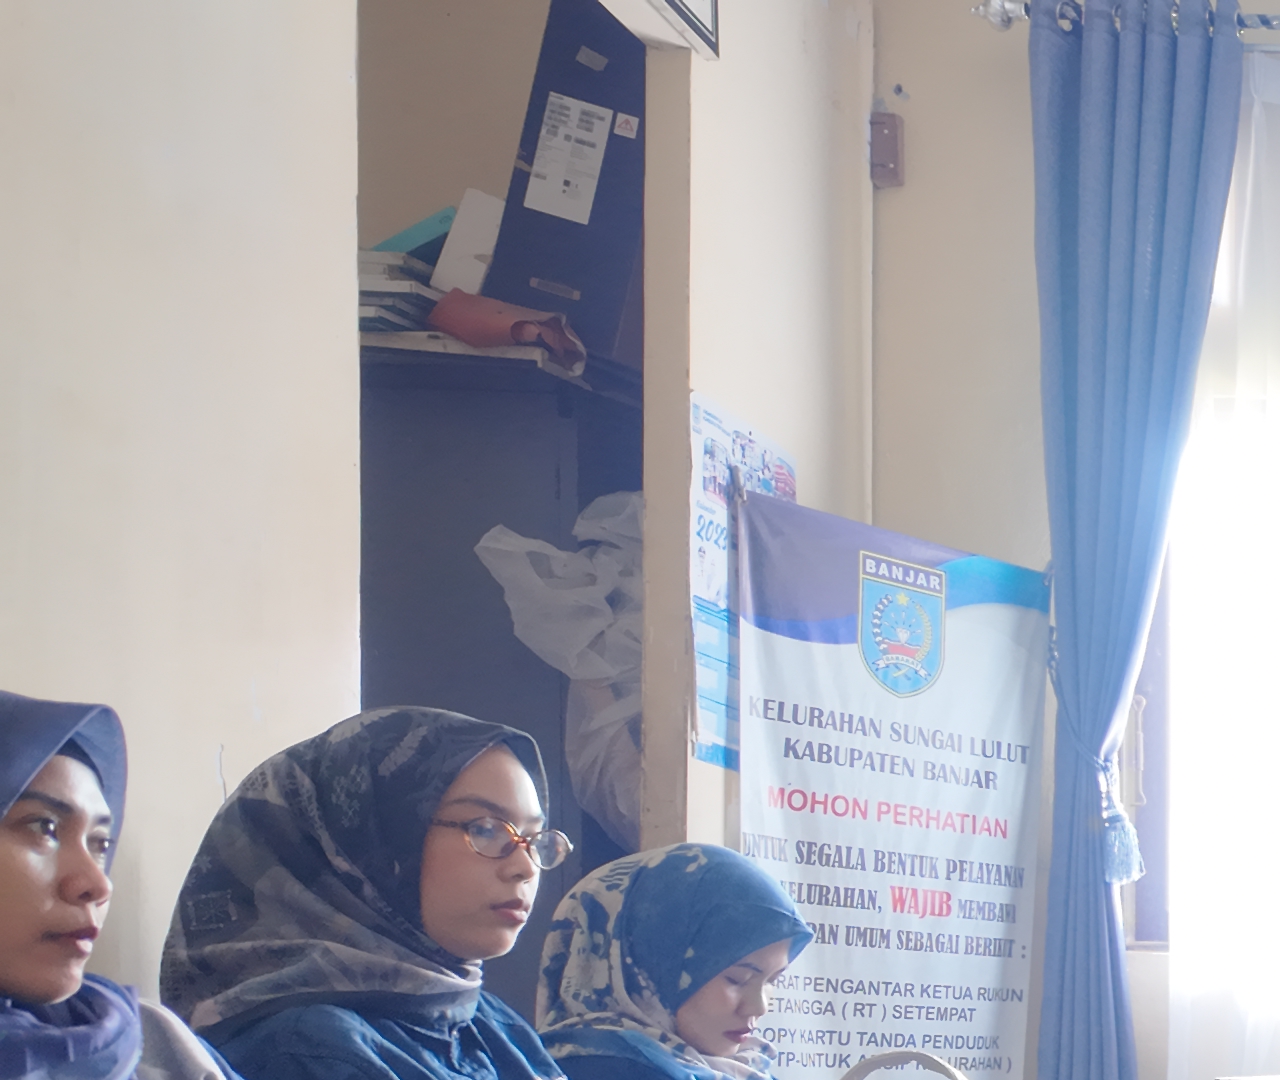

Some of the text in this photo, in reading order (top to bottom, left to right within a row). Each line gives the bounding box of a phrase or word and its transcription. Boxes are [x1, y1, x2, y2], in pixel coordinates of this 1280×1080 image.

[864, 557, 942, 591] BANJAR
[749, 695, 1030, 765] KELURAHAN SUNGAI LULUT
[783, 737, 998, 790] KABUPATEN BANJAR
[767, 785, 1008, 839] MOHON PERHATIAN
[795, 839, 867, 872] SEGALA
[873, 849, 939, 881] BENTUK
[889, 885, 952, 919] WAJIB
[845, 925, 891, 949] UMUM
[896, 928, 960, 955] SEBAGAI
[803, 976, 1024, 1003] PENGANTAR KETUA RUKUN
[892, 1005, 976, 1022] SETEMPAT
[800, 1029, 851, 1046] KARTU
[857, 1031, 917, 1048] TANDA
[922, 1034, 1000, 1051] PENDUDUK
